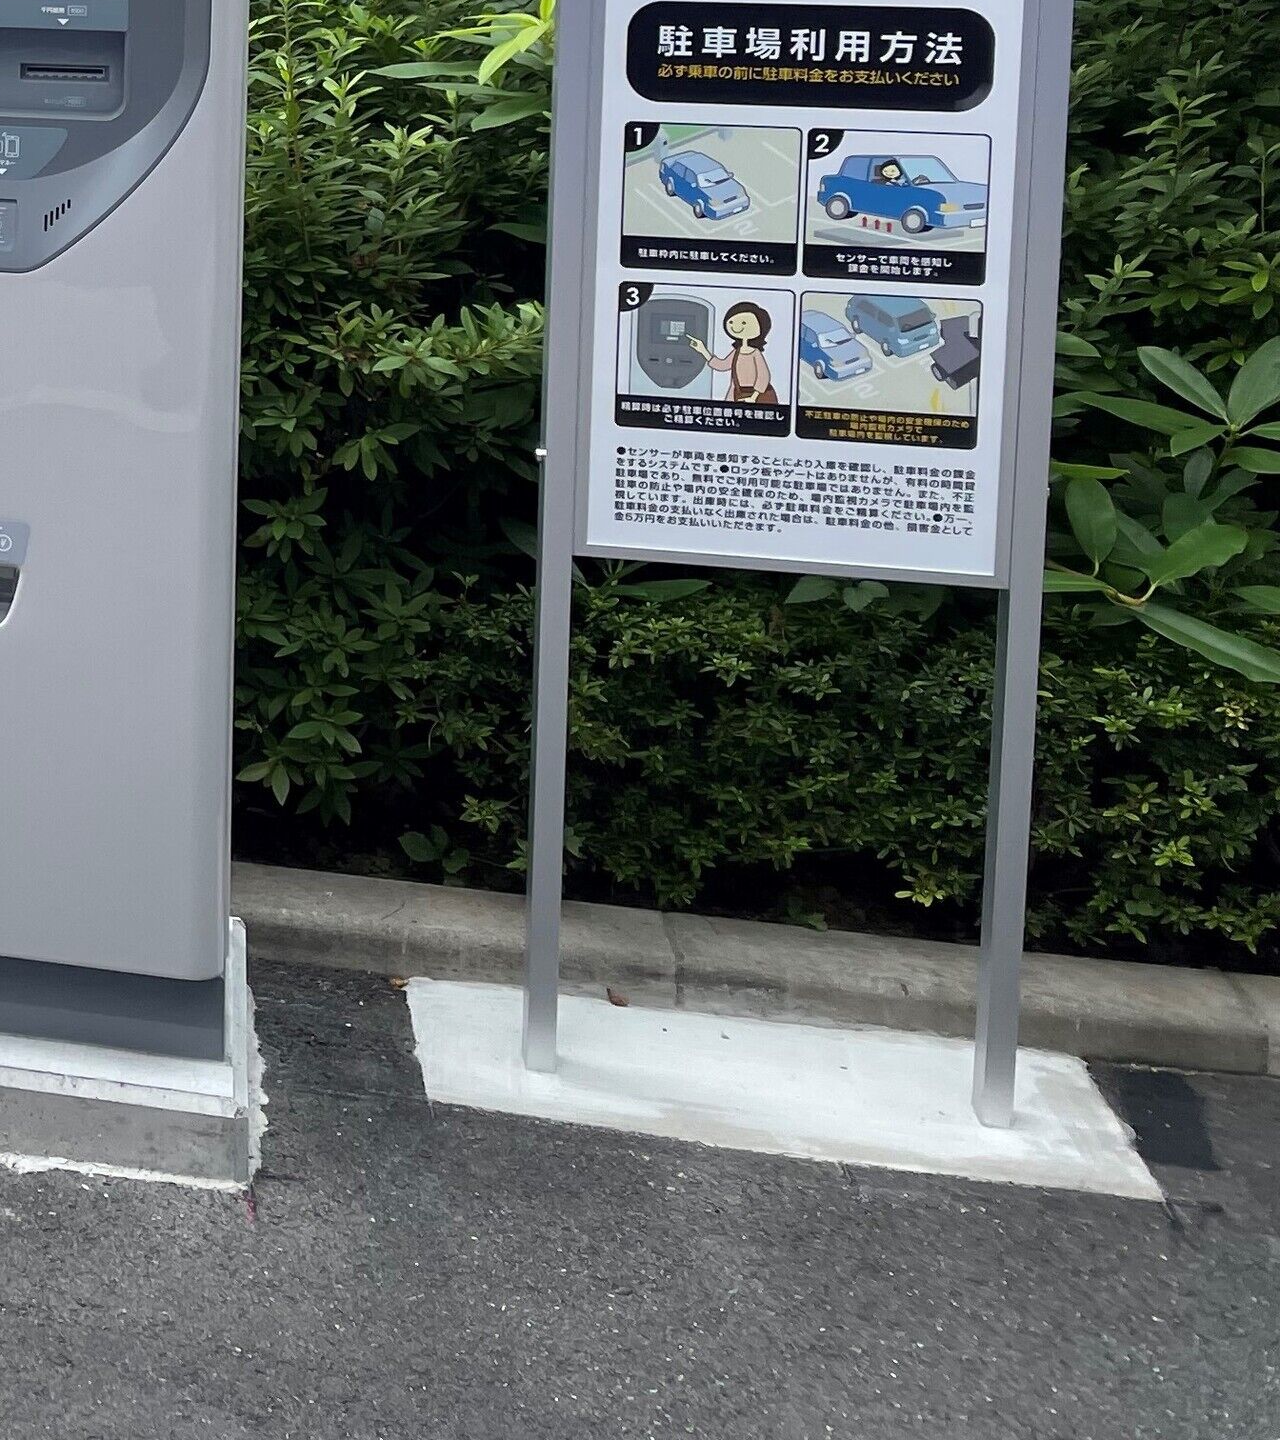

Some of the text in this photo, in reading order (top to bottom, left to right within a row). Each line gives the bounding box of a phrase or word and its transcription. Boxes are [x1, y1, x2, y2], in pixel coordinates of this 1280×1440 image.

[658, 25, 963, 65] 駐車場利用方法
[657, 63, 960, 87] 必ず乗車の前に駐車料金をお支払いください
[634, 127, 643, 145] 1
[815, 135, 829, 152] 2
[626, 287, 640, 306] 3
